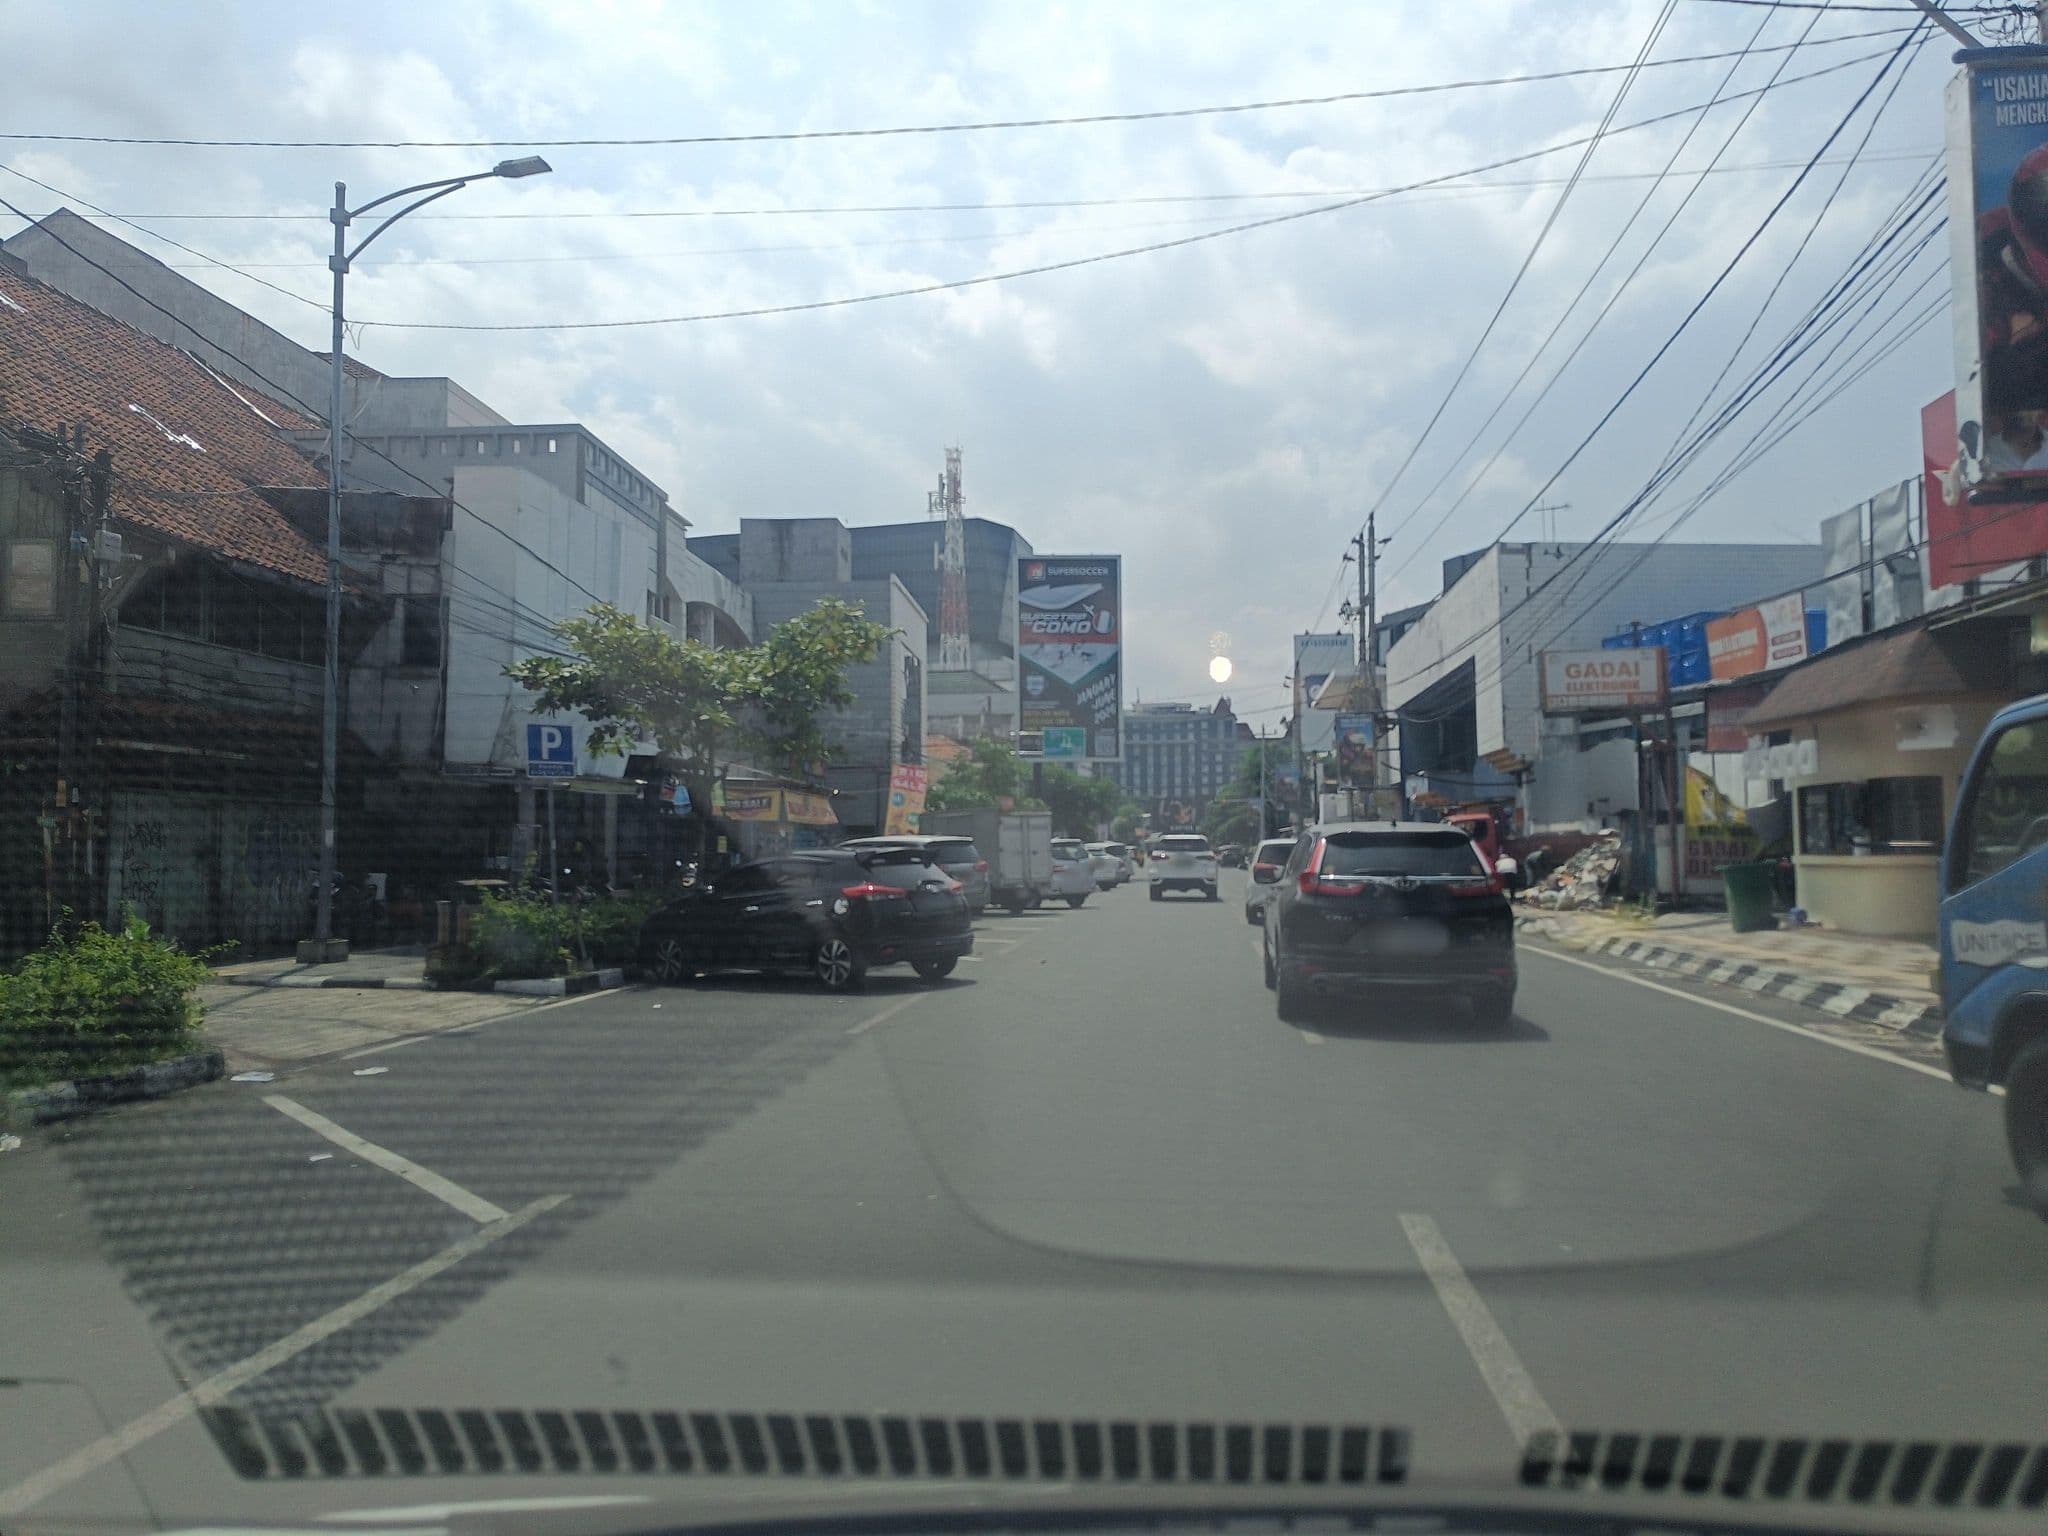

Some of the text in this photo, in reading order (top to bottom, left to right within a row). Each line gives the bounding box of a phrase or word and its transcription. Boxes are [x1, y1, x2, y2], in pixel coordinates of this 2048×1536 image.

[1032, 621, 1092, 634] COMO
[1566, 661, 1640, 679] GADAI
[541, 727, 562, 760] P
